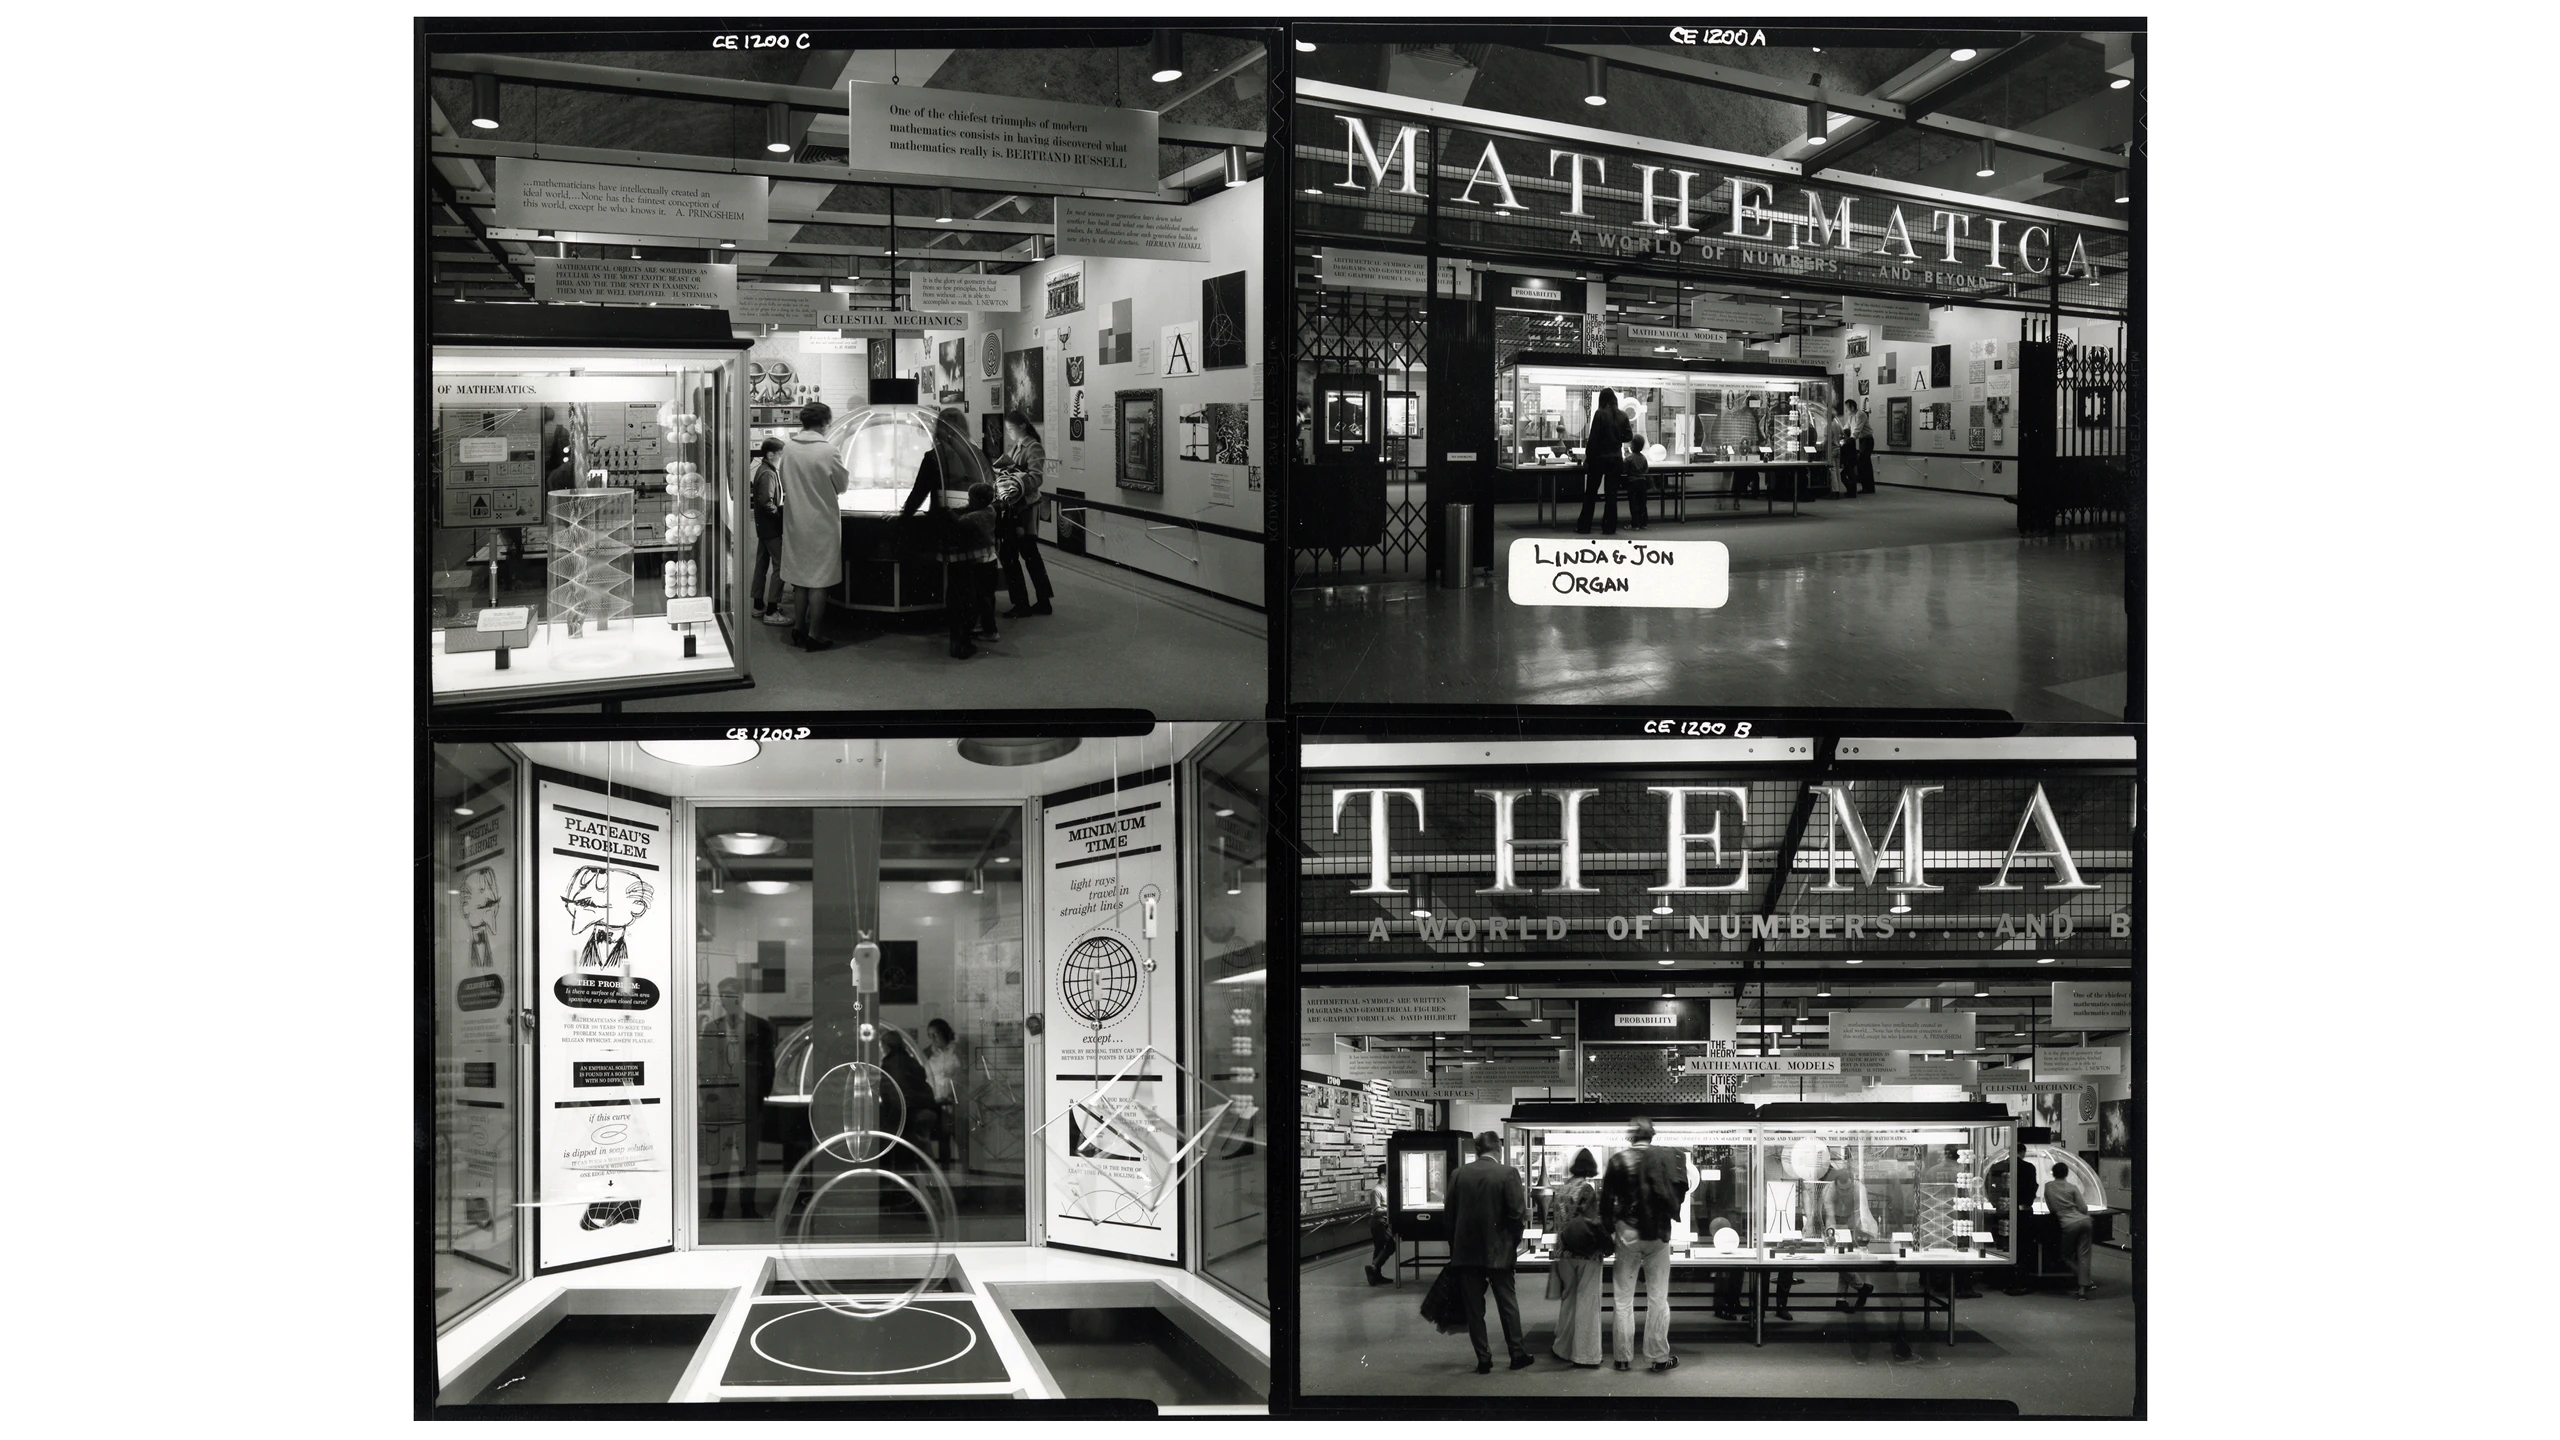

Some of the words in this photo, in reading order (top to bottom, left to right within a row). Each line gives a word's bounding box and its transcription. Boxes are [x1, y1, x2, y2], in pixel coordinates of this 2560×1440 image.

[711, 35, 739, 49] CE
[743, 35, 790, 49] 1200
[795, 33, 811, 49] C
[1669, 26, 1698, 44] CE
[1703, 29, 1748, 46] 1200
[1750, 29, 1765, 46] A
[889, 104, 911, 116] One
[913, 106, 926, 118] of
[927, 108, 945, 119] the
[947, 110, 987, 123] chiefest
[990, 114, 1037, 128] triumphs
[1038, 118, 1050, 129] of
[1051, 121, 1088, 132] modern
[889, 123, 957, 136] mathematics
[959, 129, 1001, 140] consists
[1003, 131, 1014, 142] in
[1016, 132, 1050, 146] having
[1051, 136, 1102, 150] discovered
[1105, 141, 1127, 152] what
[889, 140, 957, 153] mathematics
[959, 146, 989, 158] really
[991, 146, 1003, 158] is.
[1005, 148, 1071, 162] BERTRAND
[1073, 154, 1127, 168] RUSSELL
[597, 181, 618, 192] have
[619, 184, 669, 196] intellectually
[670, 188, 699, 198] created
[699, 191, 711, 199] an
[1333, 114, 2096, 280] MATHEMATICA
[522, 189, 543, 198] ideal
[605, 193, 620, 203] has
[621, 193, 635, 204] the
[637, 194, 666, 206] faintest
[667, 199, 710, 209] conception
[711, 199, 721, 209] of
[522, 197, 539, 208] this
[540, 199, 567, 211] world,
[567, 203, 595, 213] except
[596, 201, 608, 212] he
[609, 203, 628, 213] who
[629, 204, 656, 215] knows
[657, 206, 667, 216] it.
[675, 207, 685, 217] A.
[687, 209, 745, 220] PRINGSHEIM
[1569, 230, 1583, 245] A
[1597, 232, 1681, 256] WORLD
[1701, 245, 1727, 260] OF
[1878, 266, 1912, 282] AND
[1925, 270, 1987, 289] BEYOND
[555, 263, 611, 272] MATHEMATICAL
[612, 265, 642, 273] OBJECTS
[659, 267, 698, 275] SOMETIMES
[595, 288, 605, 296] BE
[627, 289, 666, 297] EMPLOYED.
[672, 290, 679, 298] H.
[681, 291, 718, 299] STEINHAUS
[1515, 289, 1558, 299] PROBABILITY
[823, 313, 887, 325] CELESTIAL
[893, 315, 963, 326] MECHANICS
[1586, 313, 1599, 321] THE
[1631, 328, 1691, 339] MATHEMATICAL
[1693, 331, 1725, 342] MODELS
[1166, 333, 1193, 375] A
[436, 384, 452, 395] OF
[456, 384, 537, 395] MATHEMATICS.
[1533, 544, 1608, 567] LINDA
[1630, 545, 1674, 566] JON
[1552, 571, 1628, 594] ORGAN
[725, 728, 749, 740] CE
[752, 728, 794, 741] 1200
[793, 727, 812, 740] D
[1643, 719, 1676, 733] CE
[1679, 721, 1727, 735] 1200
[1733, 722, 1753, 738] B
[564, 817, 650, 845] PLATEAU'S
[1068, 816, 1146, 842] MINIMUM
[1085, 835, 1128, 853] TIME
[1332, 782, 2138, 895] THEMA
[568, 833, 647, 859] PROBLEM
[1069, 878, 1092, 891] light
[1094, 876, 1116, 887] rays
[1088, 886, 1116, 900] travel
[1118, 884, 1130, 896] in
[1059, 902, 1097, 916] straight
[1099, 899, 1124, 912] lines
[1369, 917, 1390, 941] A
[1416, 916, 1567, 941] WORLD
[1607, 915, 1653, 940] OF
[1995, 913, 2074, 938] AND
[576, 979, 596, 988] THE
[597, 980, 641, 990] PROBLM:
[1307, 997, 1361, 1006] ARITHMETICAL
[1361, 997, 1395, 1005] SYMBOLS
[1396, 996, 1412, 1005] ARE
[1411, 996, 1447, 1004] WRITTEN
[2072, 991, 2086, 999] One
[2085, 991, 2094, 999] of
[2093, 991, 2104, 999] the
[2104, 991, 2127, 999] chiefest
[1306, 1006, 1343, 1014] DIAGRAMS
[1344, 1005, 1359, 1014] AND
[1360, 1005, 1413, 1014] GEOMETRICAL
[1413, 1005, 1446, 1013] FIGURES
[2072, 1000, 2110, 1008] mathematics
[1307, 1015, 1322, 1023] ARE
[1322, 1015, 1355, 1023] GRAPHIC
[1399, 1013, 1423, 1022] DAVID
[1424, 1013, 1457, 1022] HILBERT
[1618, 1015, 1672, 1025] PROBABILITY
[1081, 1033, 1124, 1045] except...
[1710, 1039, 1727, 1050] THE
[1710, 1049, 1737, 1058] HEORY
[1690, 1060, 1781, 1071] MATHEMATICAL
[1787, 1060, 1835, 1071] MODELS
[1326, 1075, 1342, 1087] 1700
[1710, 1075, 1737, 1085] LITIES
[1393, 1089, 1431, 1097] MINIMAL
[1432, 1089, 1475, 1097] SURFACES
[1710, 1084, 1719, 1094] IS
[1724, 1084, 1737, 1094] NO
[1985, 1084, 2028, 1092] CELESTIAL
[2033, 1083, 2084, 1091] MECHANICS
[1710, 1094, 1737, 1104] THING
[588, 1112, 596, 1124] if
[595, 1112, 611, 1122] this
[611, 1113, 632, 1121] curve
[562, 1149, 571, 1159] is
[571, 1147, 598, 1158] dipped
[598, 1146, 607, 1155] in
[608, 1146, 625, 1155] soap
[627, 1142, 653, 1152] solution
